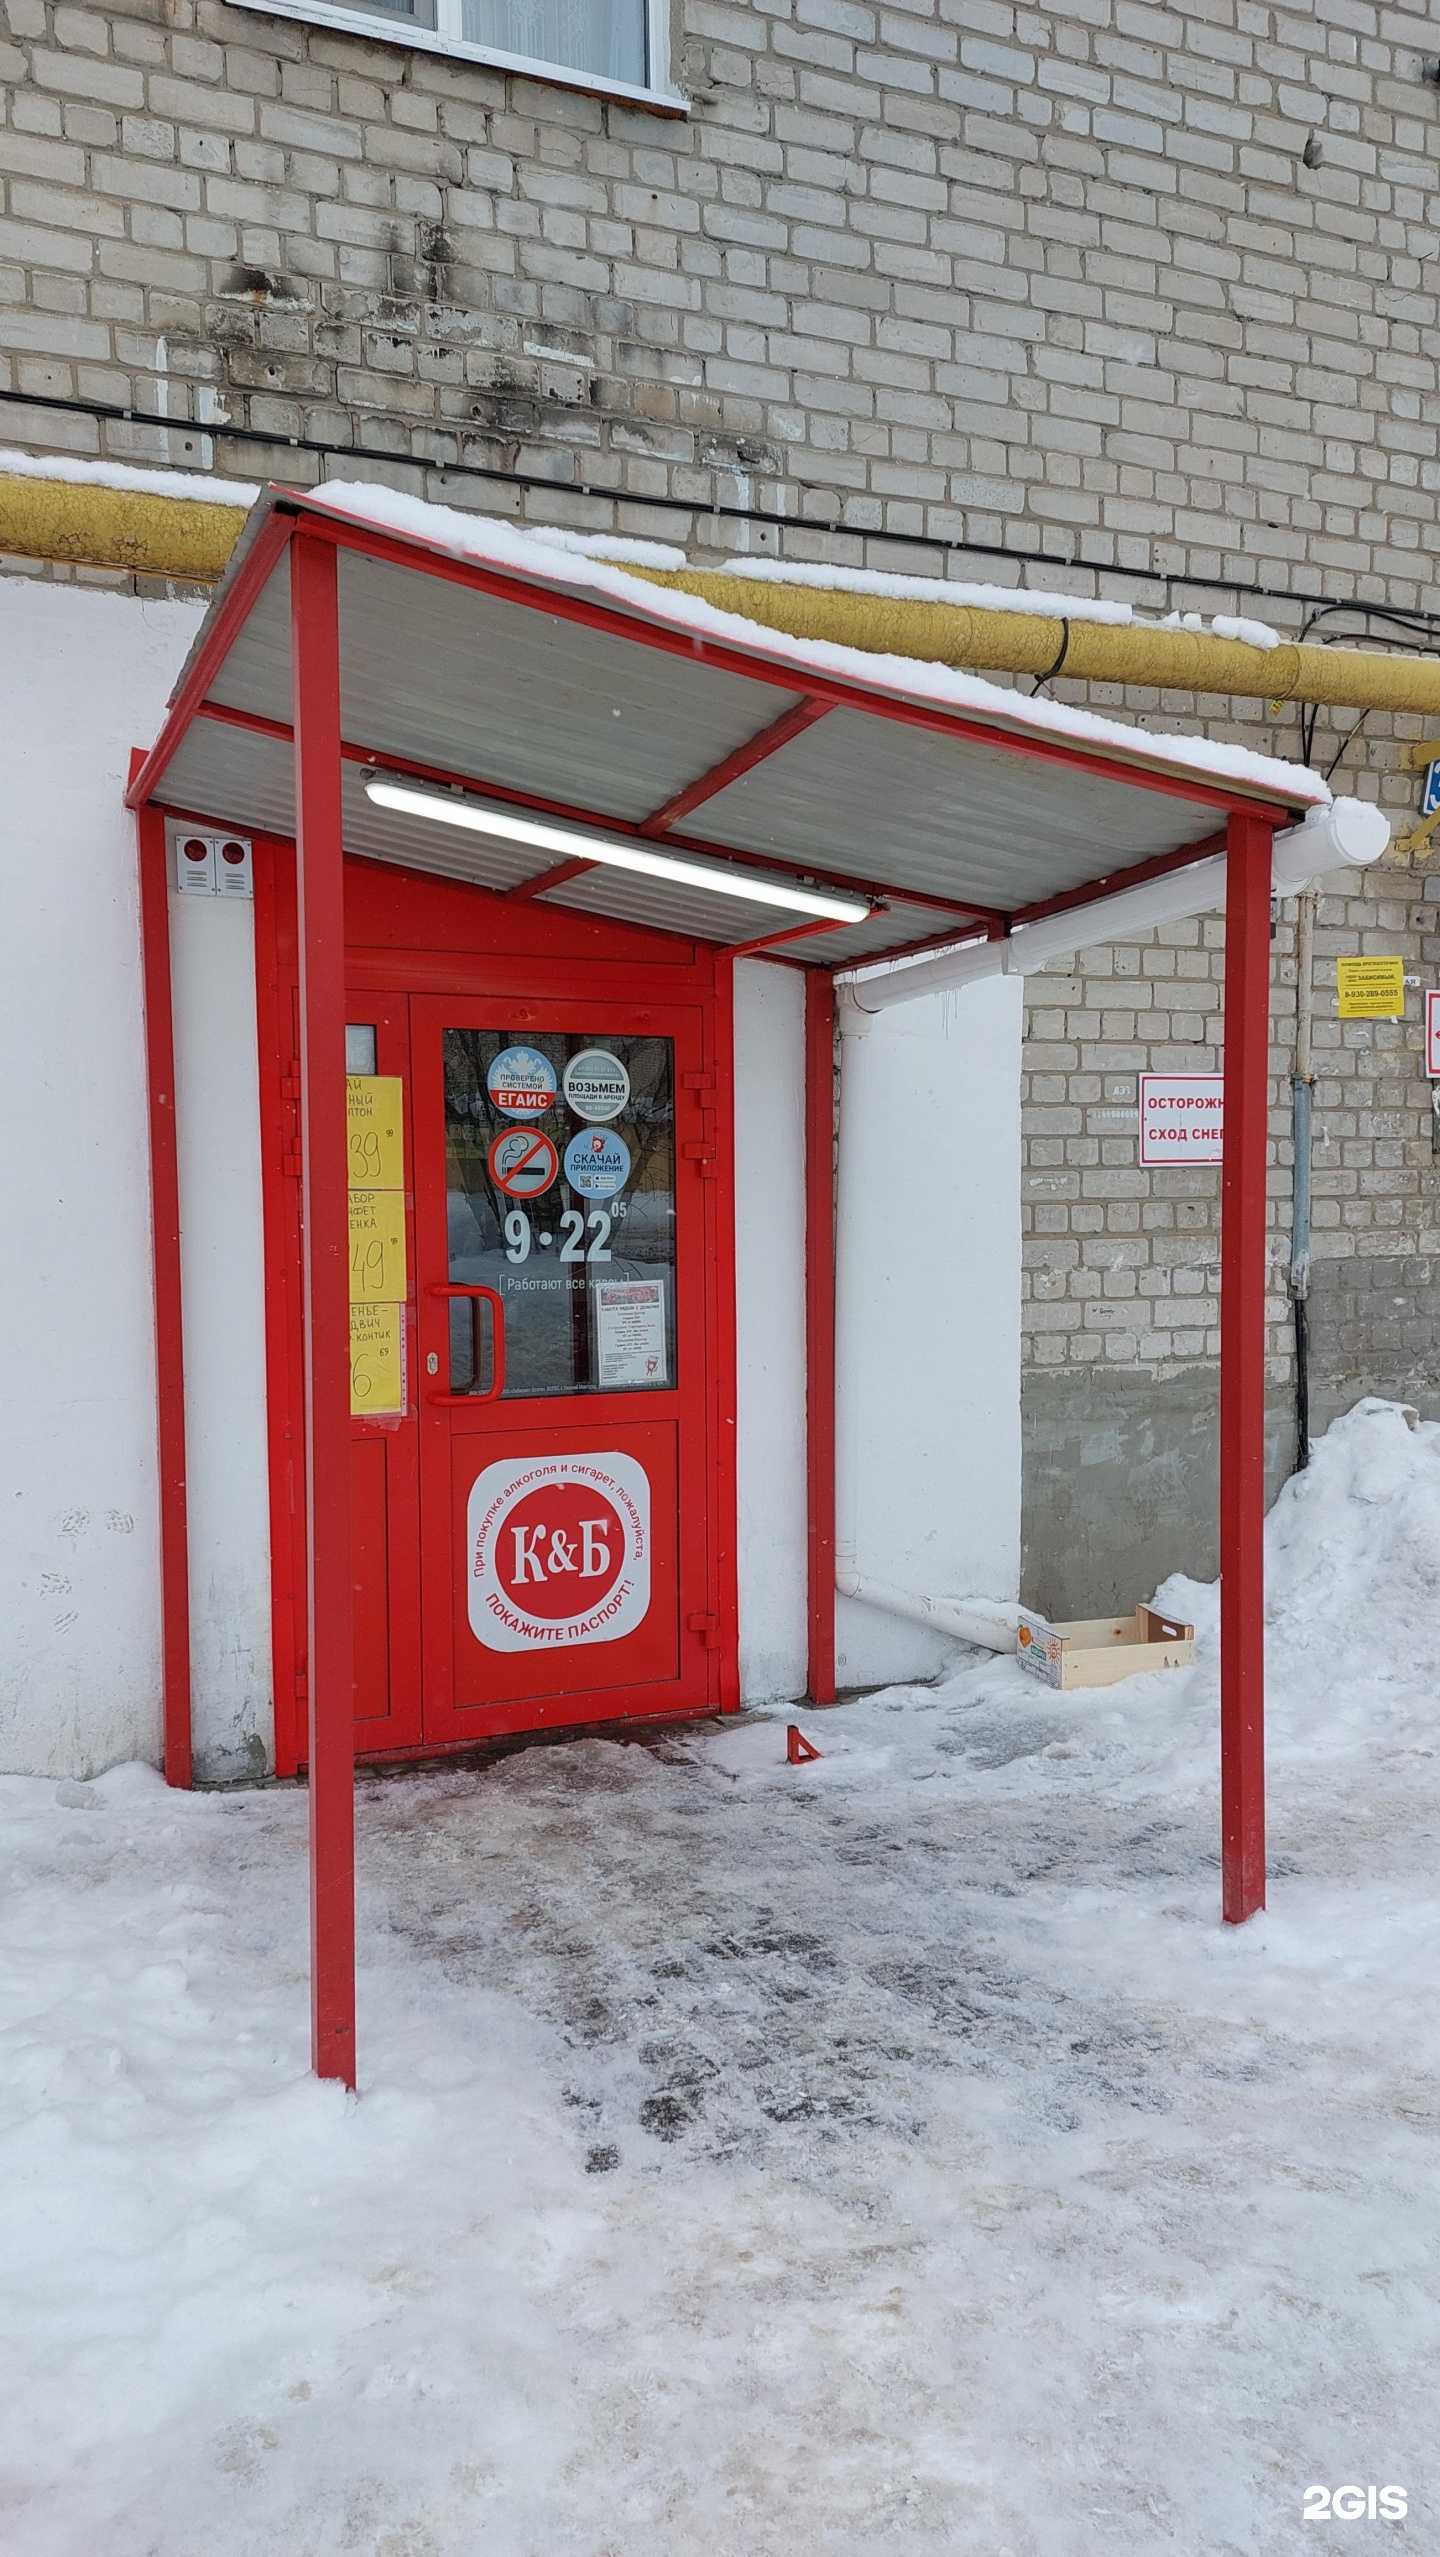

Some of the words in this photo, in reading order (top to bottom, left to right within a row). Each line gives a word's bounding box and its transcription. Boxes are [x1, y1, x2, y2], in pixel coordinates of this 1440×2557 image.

[500, 1074, 545, 1083] ПРОВЕРЕНО
[502, 1081, 543, 1090] СИСТЕМОЙ
[568, 1082, 625, 1093] ВОЗЬМЕМ
[498, 1092, 548, 1107] ЕГАИС
[1148, 1129, 1188, 1142] СХОД
[350, 1131, 381, 1178] 39
[573, 1152, 621, 1164] СКАЧАЙ
[570, 1164, 625, 1172] ПРИЛОЖЕНИЕ
[611, 1202, 627, 1217] 05
[352, 1240, 384, 1292] 49
[507, 1278, 561, 1290] Работают
[566, 1280, 585, 1289] все
[560, 1464, 568, 1473] и
[504, 1464, 557, 1498] алкоголя
[571, 1464, 616, 1491] сигарет,
[476, 1496, 505, 1547] покупке
[616, 1486, 645, 1561] пожалуйста,
[511, 1519, 611, 1584] К&Б
[474, 1552, 487, 1578] При
[485, 1592, 564, 1641] ПОКАЖИТЕ
[568, 1579, 636, 1639] ПАСПОРТ!
